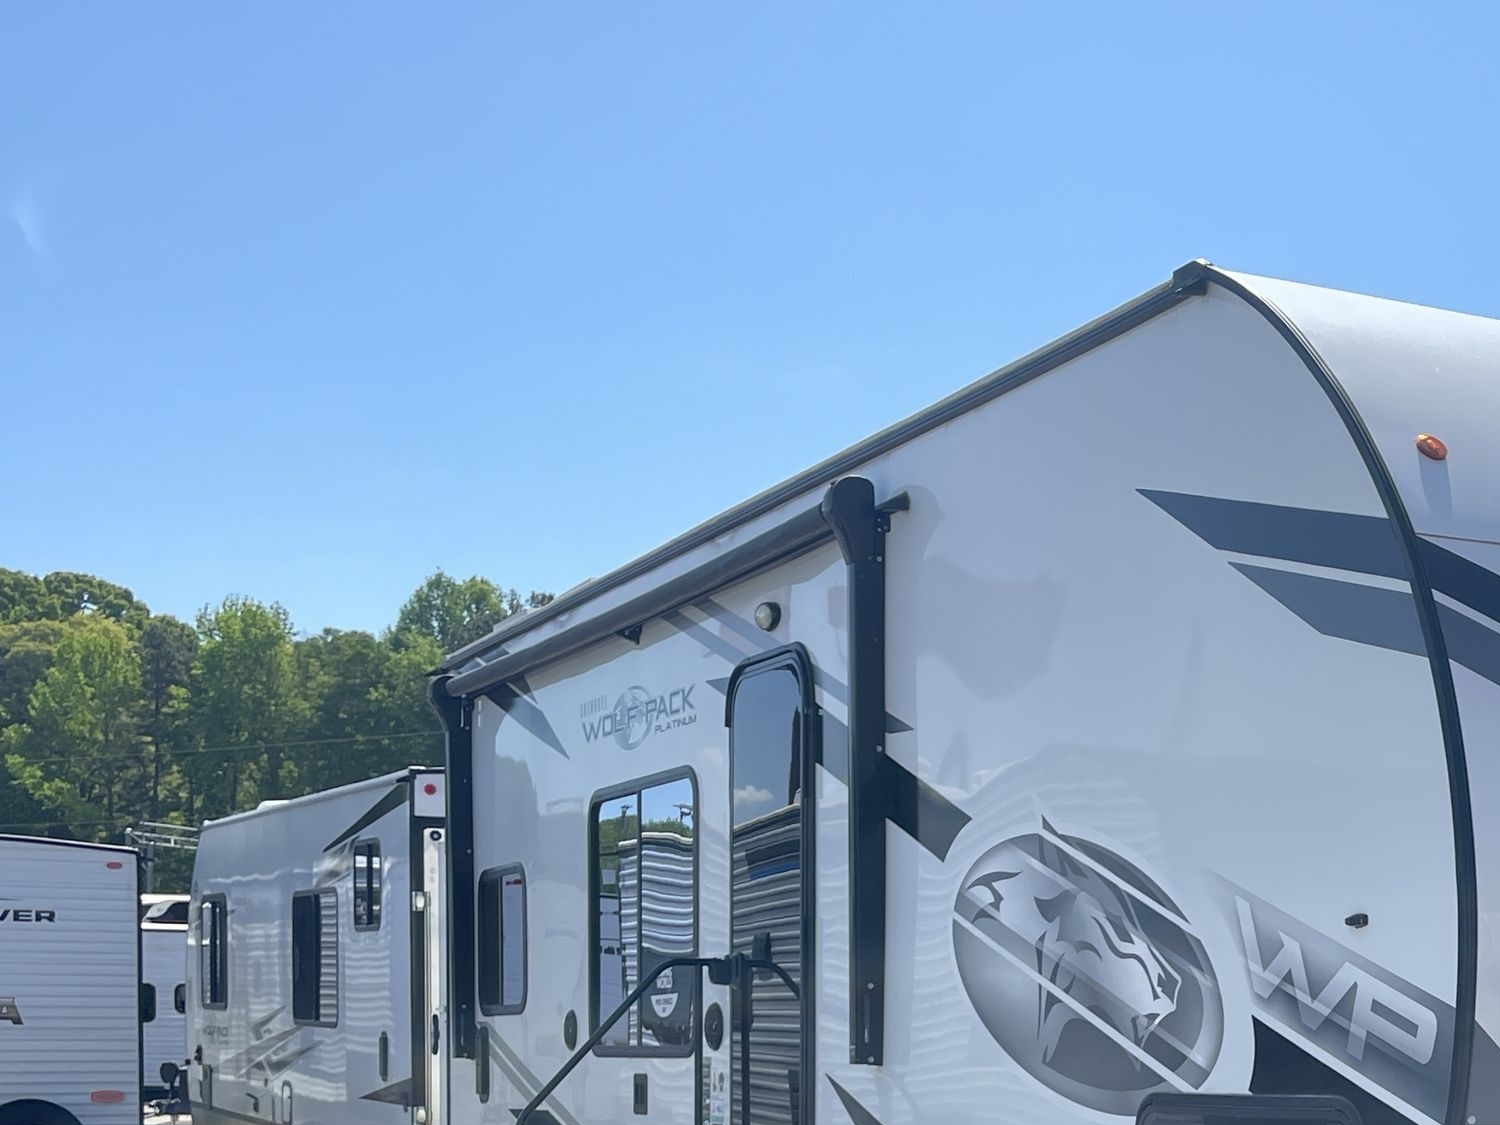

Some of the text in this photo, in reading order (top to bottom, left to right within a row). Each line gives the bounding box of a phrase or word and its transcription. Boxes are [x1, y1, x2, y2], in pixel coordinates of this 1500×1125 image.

[582, 704, 639, 743] WOLF
[644, 683, 697, 723] PACK
[654, 714, 698, 735] PLATINUM
[1235, 895, 1438, 1065] WP
